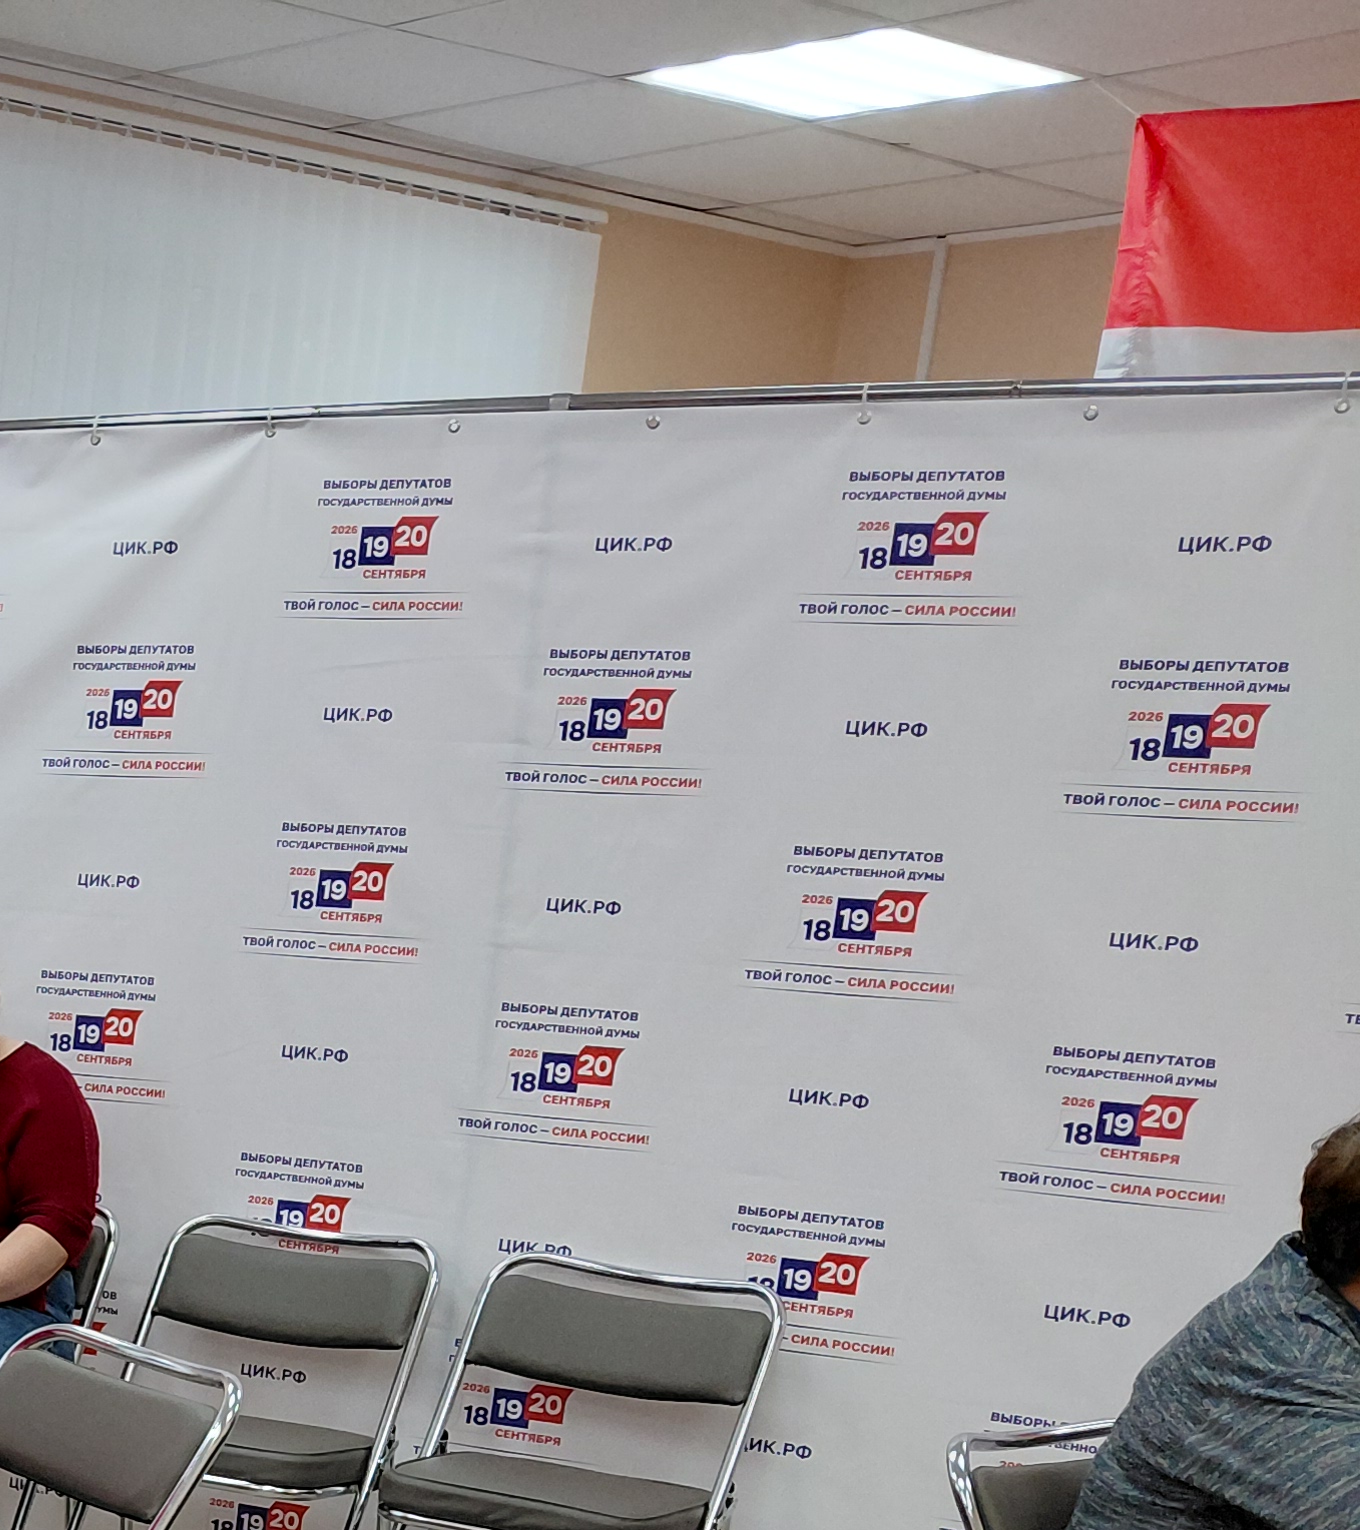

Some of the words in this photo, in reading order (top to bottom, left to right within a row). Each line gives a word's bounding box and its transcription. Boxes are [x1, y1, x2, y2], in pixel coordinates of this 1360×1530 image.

[324, 480, 377, 489] ВЫБОРЫ
[379, 479, 451, 490] ДЕПУТАТОВ
[849, 472, 913, 482] ВЫБОРЫ
[916, 471, 1004, 483] ДЕПУТАТОВ
[318, 496, 419, 507] ГОСУДАРСТВЕННОЙ
[421, 497, 454, 508] ДУМЫ
[842, 489, 964, 501] ГОСУДАРСТВЕННОЙ
[967, 492, 1006, 501] ДУМЫ
[331, 526, 357, 534] 2026
[857, 522, 889, 531] 2026
[933, 521, 974, 545] 20
[394, 525, 428, 547] 20
[113, 541, 178, 556] ЦИК.РФ
[364, 537, 388, 557] 19
[596, 537, 672, 554] ЦИК.РФ
[897, 534, 927, 557] 19
[1179, 536, 1272, 555] ЦИК.РФ
[333, 549, 356, 569] 18
[859, 548, 887, 569] 18
[363, 570, 426, 578] СЕНТЯБРЯ
[895, 570, 972, 581] СЕНТЯБРЯ
[284, 599, 316, 611] ТВОЙ
[318, 601, 359, 611] ГОЛОС
[373, 602, 405, 610] СИЛА
[409, 602, 462, 611] РОССИИ!
[800, 602, 837, 614] ТВОЙ
[841, 605, 889, 615] ГОЛОС
[905, 605, 945, 615] СИЛА
[949, 607, 1015, 617] РОССИИ!
[77, 645, 126, 654] ВЫБОРЫ
[129, 645, 194, 655] ДЕПУТАТОВ
[73, 661, 165, 671] ГОСУДАРСТВЕННОЙ
[166, 663, 196, 671] ДУМЫ
[1120, 660, 1190, 671] ВЫБОРЫ
[1192, 661, 1289, 673] ДЕПУТАТОВ
[1112, 680, 1245, 691] ГОСУДАРСТВЕННОЙ
[1247, 683, 1290, 693] ДУМЫ
[142, 686, 176, 711] 20
[115, 699, 137, 719] 19
[324, 708, 392, 723] ЦИК.РФ
[1128, 712, 1163, 721] 2026
[87, 711, 108, 729] 18
[1209, 713, 1254, 738] 20
[114, 730, 171, 739] СЕНТЯБРЯ
[846, 721, 927, 737] ЦИК.РФ
[1171, 725, 1203, 749] 19
[1130, 738, 1160, 761] 18
[42, 757, 70, 767] ТВОЙ
[73, 759, 109, 768] ГОЛОС
[123, 760, 152, 769] СИЛА
[155, 761, 205, 771] РОССИИ!
[1169, 762, 1251, 775] СЕНТЯБРЯ
[1064, 793, 1105, 805] ТВОЙ
[1109, 796, 1160, 807] ГОЛОС
[1179, 799, 1221, 810] СИЛА
[1226, 801, 1299, 813] РОССИИ!
[282, 822, 334, 833] ВЫБОРЫ
[336, 825, 406, 836] ДЕПУТАТОВ
[277, 840, 374, 851] ГОСУДАРСТВЕННОЙ
[376, 845, 408, 853] ДУМЫ
[290, 867, 316, 876] 2026
[351, 869, 383, 891] 20
[78, 874, 139, 888] ЦИК.РФ
[322, 879, 346, 900] 19
[291, 890, 314, 909] 18
[546, 898, 621, 915] ЦИК.РФ
[321, 911, 382, 923] СЕНТЯБРЯ
[243, 936, 274, 947] ТВОЙ
[277, 939, 316, 949] ГОЛОС
[329, 942, 361, 952] СИЛА
[364, 944, 418, 956] РОССИИ!
[1110, 933, 1198, 952] ЦИК.РФ
[282, 1045, 348, 1062] ЦИК.РФ
[1053, 1046, 1120, 1060] ВЫБОРЫ
[1123, 1052, 1215, 1068] ДЕПУТАТОВ
[1046, 1065, 1173, 1084] ГОСУДАРСТВЕННОЙ
[1176, 1077, 1217, 1087] ДУМЫ
[789, 1089, 869, 1108] ЦИК.РФ
[1062, 1097, 1094, 1108] 2026
[1103, 1113, 1133, 1136] 19
[1140, 1102, 1185, 1132] 20
[1064, 1123, 1092, 1144] 18
[1100, 1148, 1180, 1164] СЕНТЯБРЯ
[1000, 1172, 1039, 1184] ТВОЙ
[1043, 1176, 1093, 1190] ГОЛОС
[1111, 1183, 1151, 1196] СИЛА
[1156, 1188, 1225, 1203] РОССИИ!
[1044, 1305, 1130, 1327] ЦИК.РФ
[241, 1363, 306, 1383] ЦИК.РФ
[745, 1437, 812, 1459] ИК.РФ
[209, 1498, 235, 1509] 2026
[266, 1506, 299, 1530] 20
